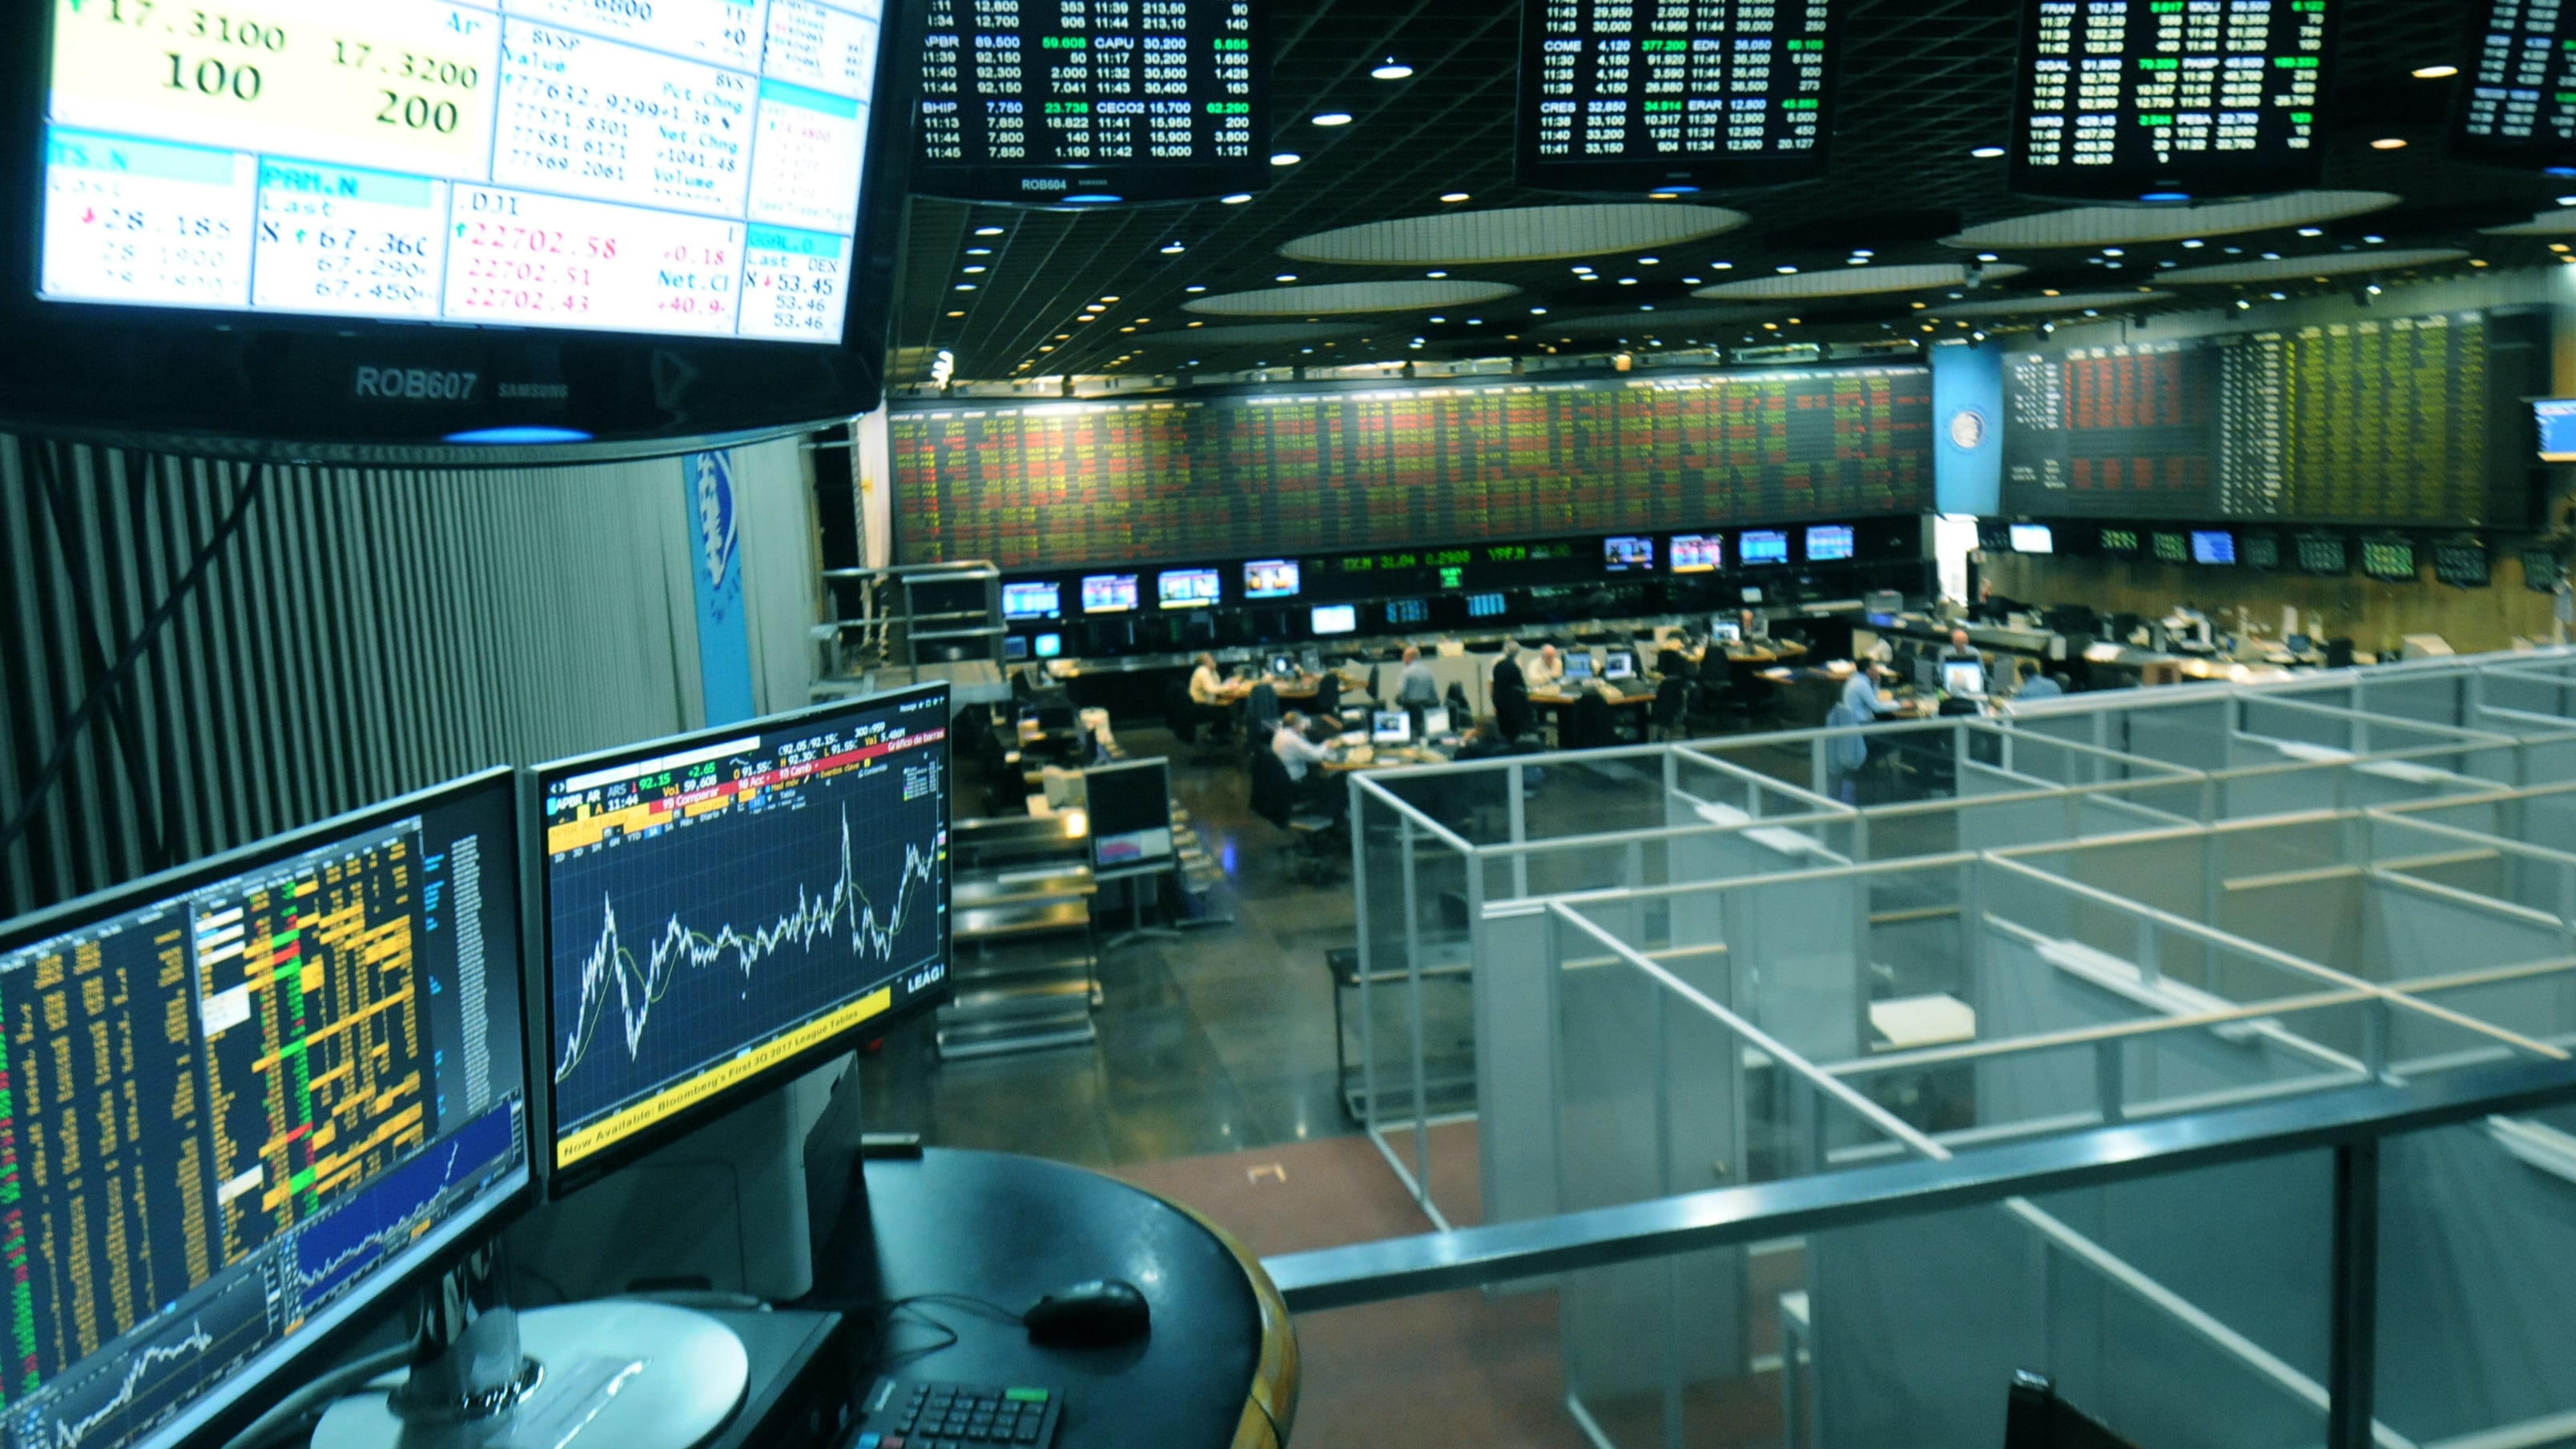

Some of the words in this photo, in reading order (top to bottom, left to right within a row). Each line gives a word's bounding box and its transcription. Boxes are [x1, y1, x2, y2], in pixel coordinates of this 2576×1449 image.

[975, 0, 1018, 12] 12,800
[1095, 1, 1129, 14] 11:39
[1232, 3, 1248, 15] 90
[1697, 7, 1725, 17] 11:41
[976, 14, 1019, 27] 12,700
[1096, 17, 1129, 28] 11:44
[1143, 17, 1185, 30] 213,10
[1226, 18, 1248, 30] 140
[1696, 21, 1724, 31] 11:44
[1094, 37, 1134, 49] CAPU
[1144, 37, 1186, 50] 30,200
[1544, 40, 1582, 52] COME
[1693, 40, 1720, 51] EDN
[924, 51, 956, 62] 11:39
[1070, 52, 1087, 63] 50
[1097, 52, 1129, 64] 11:17
[1144, 52, 1186, 65] 30,200
[1693, 54, 1721, 64] 11:41
[332, 38, 479, 90] 17.3200
[923, 66, 956, 78] 11:40
[1051, 66, 1087, 78] 2.000
[1097, 66, 1130, 78] 11:32
[1215, 67, 1249, 79] 1.428
[1693, 67, 1721, 78] 11:44
[160, 50, 261, 101] 100
[376, 88, 458, 135] 200
[923, 82, 957, 92] 11:44
[1053, 82, 1085, 93] 7.041
[1097, 82, 1130, 93] 11:43
[1145, 82, 1187, 94] 30,400
[1226, 82, 1249, 94] 163
[923, 102, 957, 113] BHIP
[987, 102, 1023, 114] 7,750
[1096, 102, 1145, 114] CECO2
[1149, 102, 1191, 114] 15,700
[1540, 102, 1576, 113] CRES
[1688, 100, 1722, 111] ERAR
[924, 118, 959, 128] 11:13
[1098, 117, 1129, 127] 11:41
[1226, 116, 1249, 128] 200
[926, 132, 960, 143] 11:44
[988, 132, 1024, 143] 7,800
[1067, 131, 1089, 143] 140
[1099, 131, 1130, 142] 11:41
[1540, 130, 1571, 140] 11:40
[927, 147, 960, 158] 11:45
[1056, 147, 1089, 157] 1.190
[1100, 146, 1132, 156] 11:42
[1151, 145, 1192, 157] 16,000
[1216, 145, 1247, 156] 1.121
[1540, 143, 1568, 154] 11:41
[1021, 179, 1067, 191] ROB604
[472, 222, 618, 260] 22702.58
[468, 258, 591, 287] 22702.51
[777, 274, 833, 296] 53.45
[465, 287, 590, 313] 22702.43
[775, 295, 826, 312] 53.46
[773, 312, 823, 329] 53.46
[355, 365, 477, 400] ROB607
[497, 382, 569, 398] SAMSUNG
[888, 738, 913, 752] Gráfico
[913, 737, 921, 745] de
[920, 731, 944, 743] barras
[662, 783, 680, 797] Vol
[683, 775, 718, 792] 59,608
[780, 758, 787, 768] H
[824, 747, 830, 757] L
[865, 735, 878, 747] Val
[820, 767, 844, 779] Eventos
[845, 762, 860, 772] clave
[556, 794, 583, 810] APBR
[586, 790, 602, 803] AR
[607, 783, 627, 797] ARS
[638, 773, 671, 790] 92.15
[687, 763, 715, 778] +2.65
[607, 794, 638, 811] 11:44
[675, 787, 720, 806] Comparar
[627, 832, 642, 843] YTD
[563, 1138, 593, 1159] Now
[596, 1107, 656, 1145] Available:
[657, 1072, 726, 1113] Bloomberg's
[728, 1060, 752, 1082] First
[754, 1052, 769, 1066] 3Q
[770, 1042, 793, 1060] 2017
[794, 1024, 829, 1048] League
[829, 1008, 859, 1031] Tables
